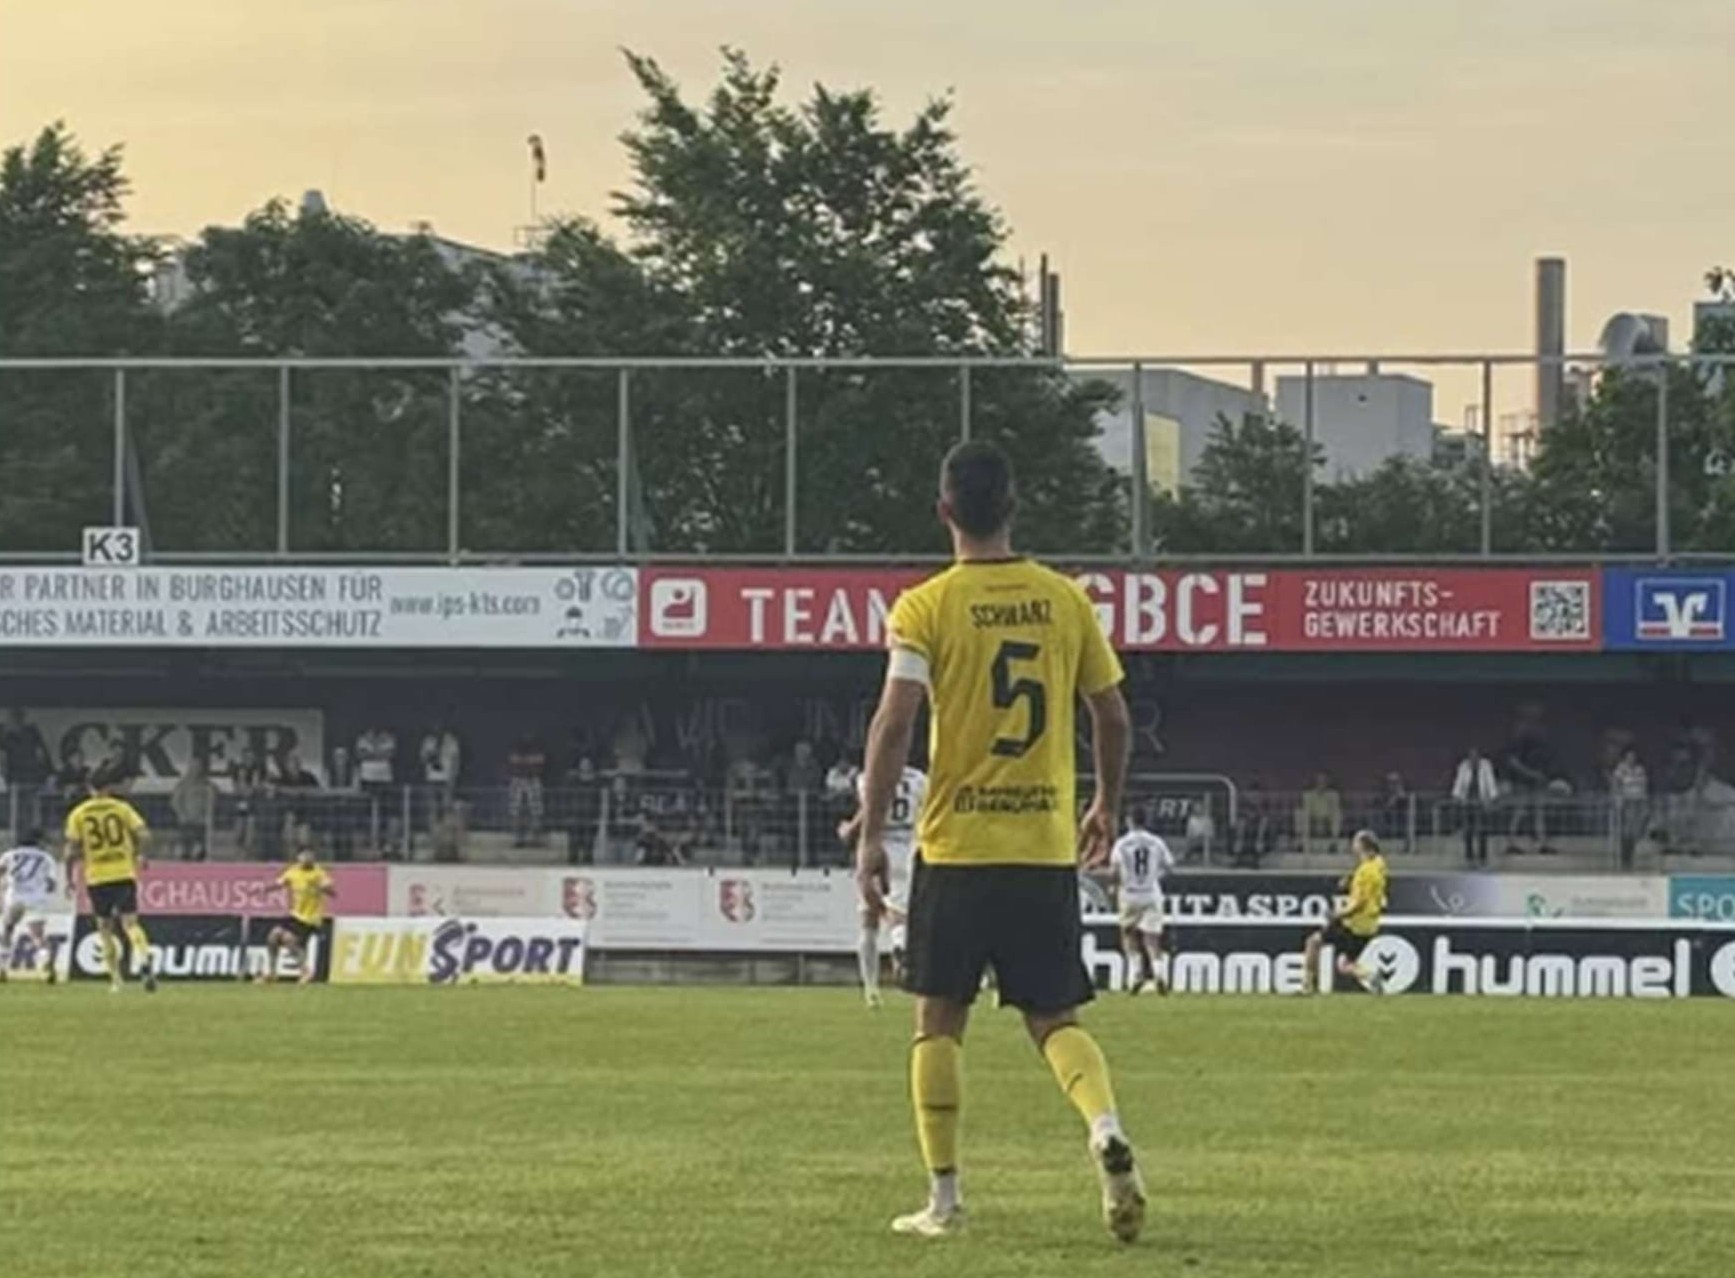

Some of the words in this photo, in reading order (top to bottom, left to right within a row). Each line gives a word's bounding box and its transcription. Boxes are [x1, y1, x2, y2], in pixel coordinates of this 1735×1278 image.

[88, 532, 134, 562] K3
[25, 574, 125, 599] PARTNER
[136, 575, 160, 599] IN
[170, 573, 326, 600] BURGHAUSEN
[338, 571, 382, 600] FÜR
[1304, 581, 1454, 607] ZUKUNFTS-
[66, 609, 166, 636] MATERIAL
[177, 609, 193, 636] &
[206, 609, 382, 637] ARBEITSSCHUTZ
[970, 598, 1054, 627] SCHWARZ
[1304, 611, 1501, 638] GEWERKSCHAFT
[990, 640, 1047, 758] 5
[84, 813, 124, 850] 30
[335, 932, 427, 975] FUN
[429, 919, 580, 984] SPORT
[1081, 933, 1335, 993] hmmel
[1432, 936, 1691, 997] hummel
